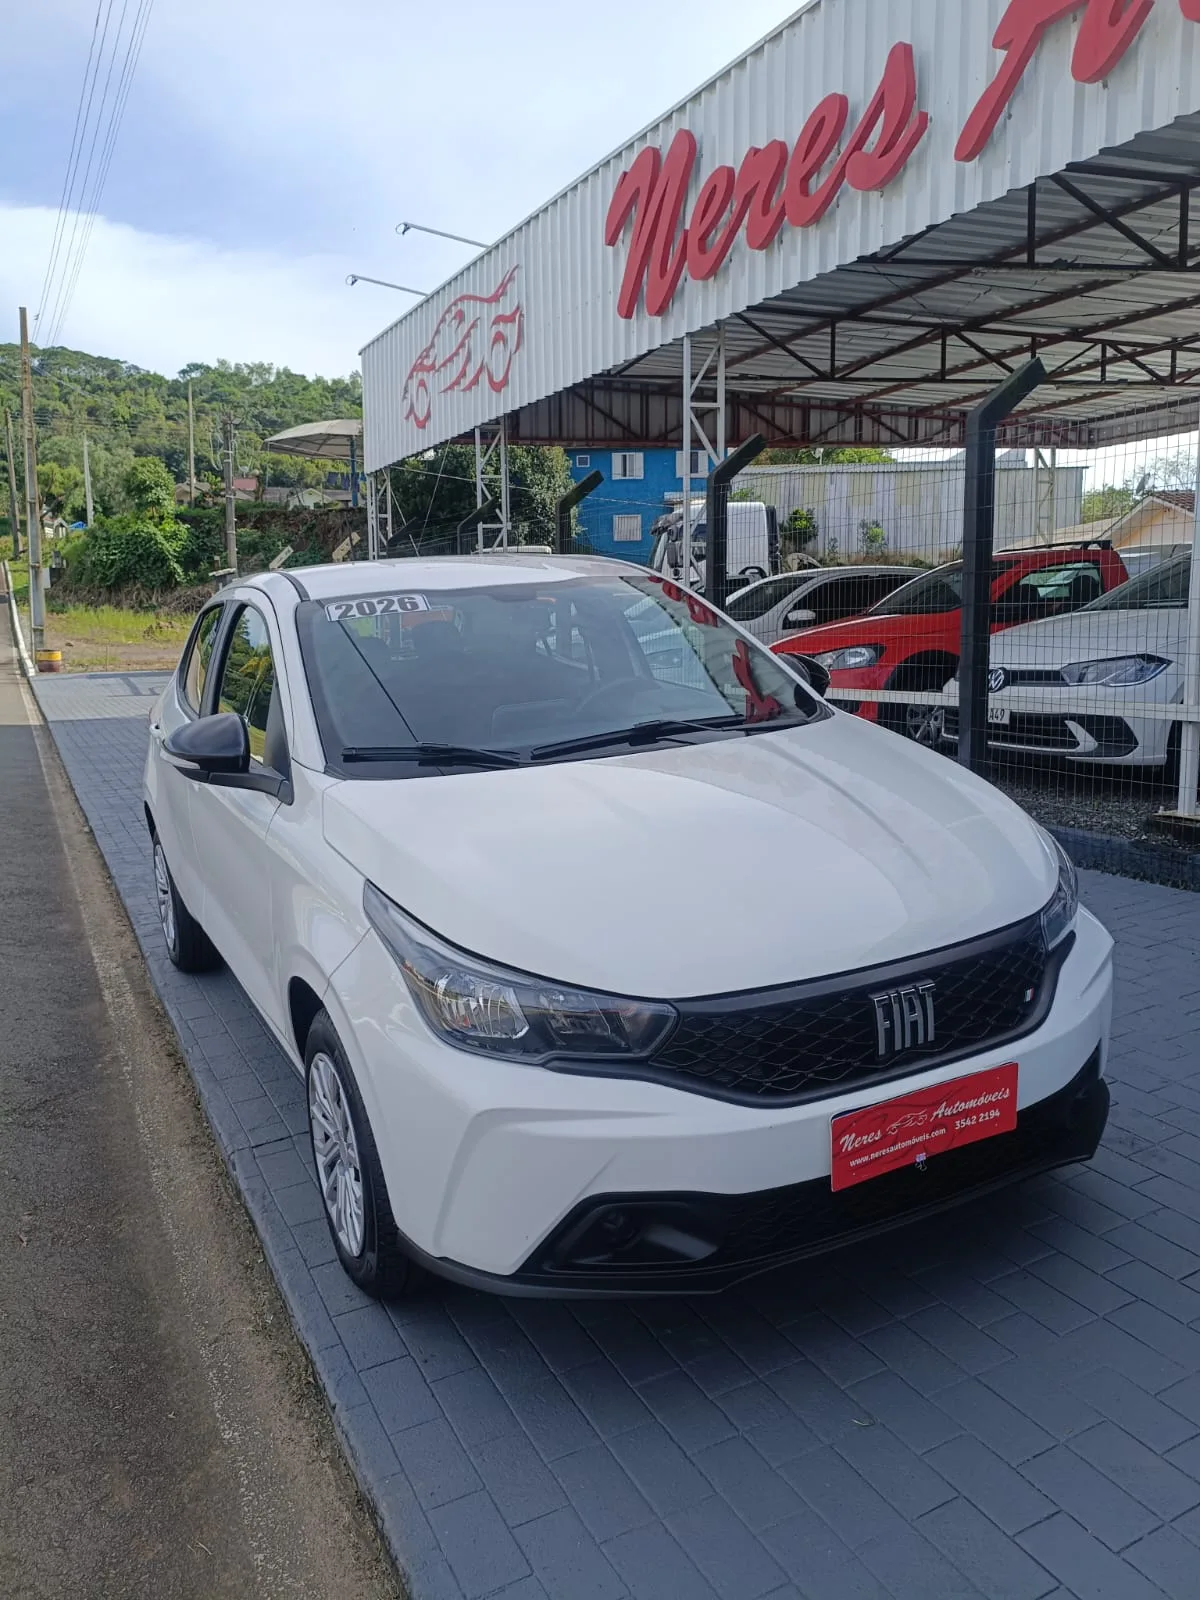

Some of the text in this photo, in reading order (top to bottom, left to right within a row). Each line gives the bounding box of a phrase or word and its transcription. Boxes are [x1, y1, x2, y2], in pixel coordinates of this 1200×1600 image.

[605, 41, 928, 319] Neres
[334, 596, 420, 619] 2026
[873, 982, 936, 1056] FIAT
[839, 1087, 1010, 1153] Neres Automóveis
[954, 1115, 977, 1130] 3542
[978, 1108, 1001, 1122] 2194
